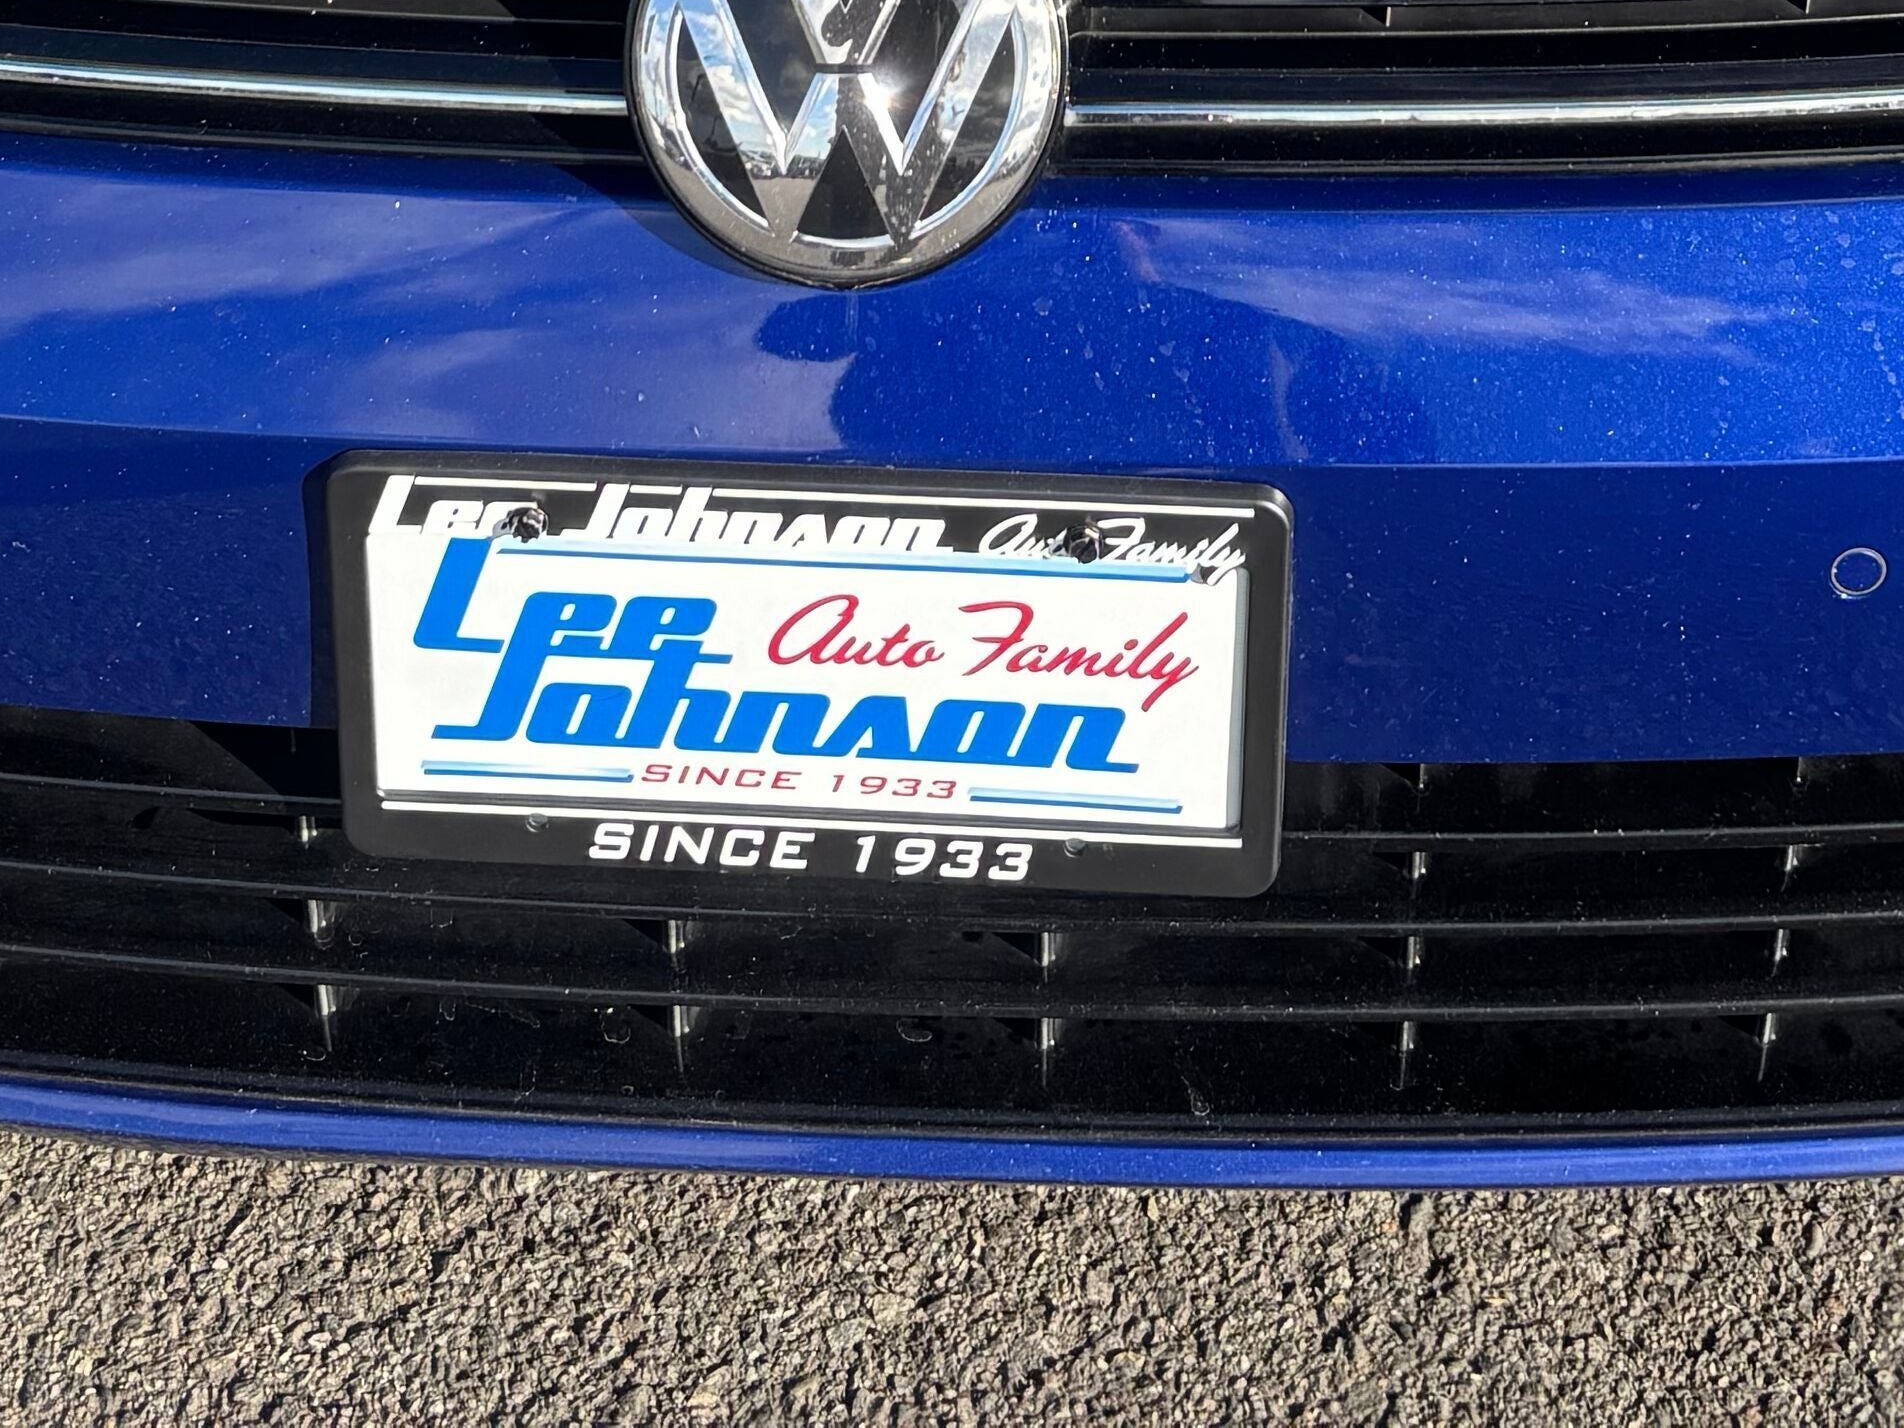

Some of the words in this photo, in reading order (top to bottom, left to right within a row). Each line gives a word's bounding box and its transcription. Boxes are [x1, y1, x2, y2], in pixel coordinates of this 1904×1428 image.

[412, 537, 732, 665] Lee
[768, 594, 945, 666] Auto
[958, 601, 1199, 712] Family
[431, 639, 1139, 774] Johnson
[641, 764, 803, 790] SINCE
[832, 774, 957, 799] 1933
[588, 821, 815, 870] SINCE
[855, 834, 1033, 882] 1933
